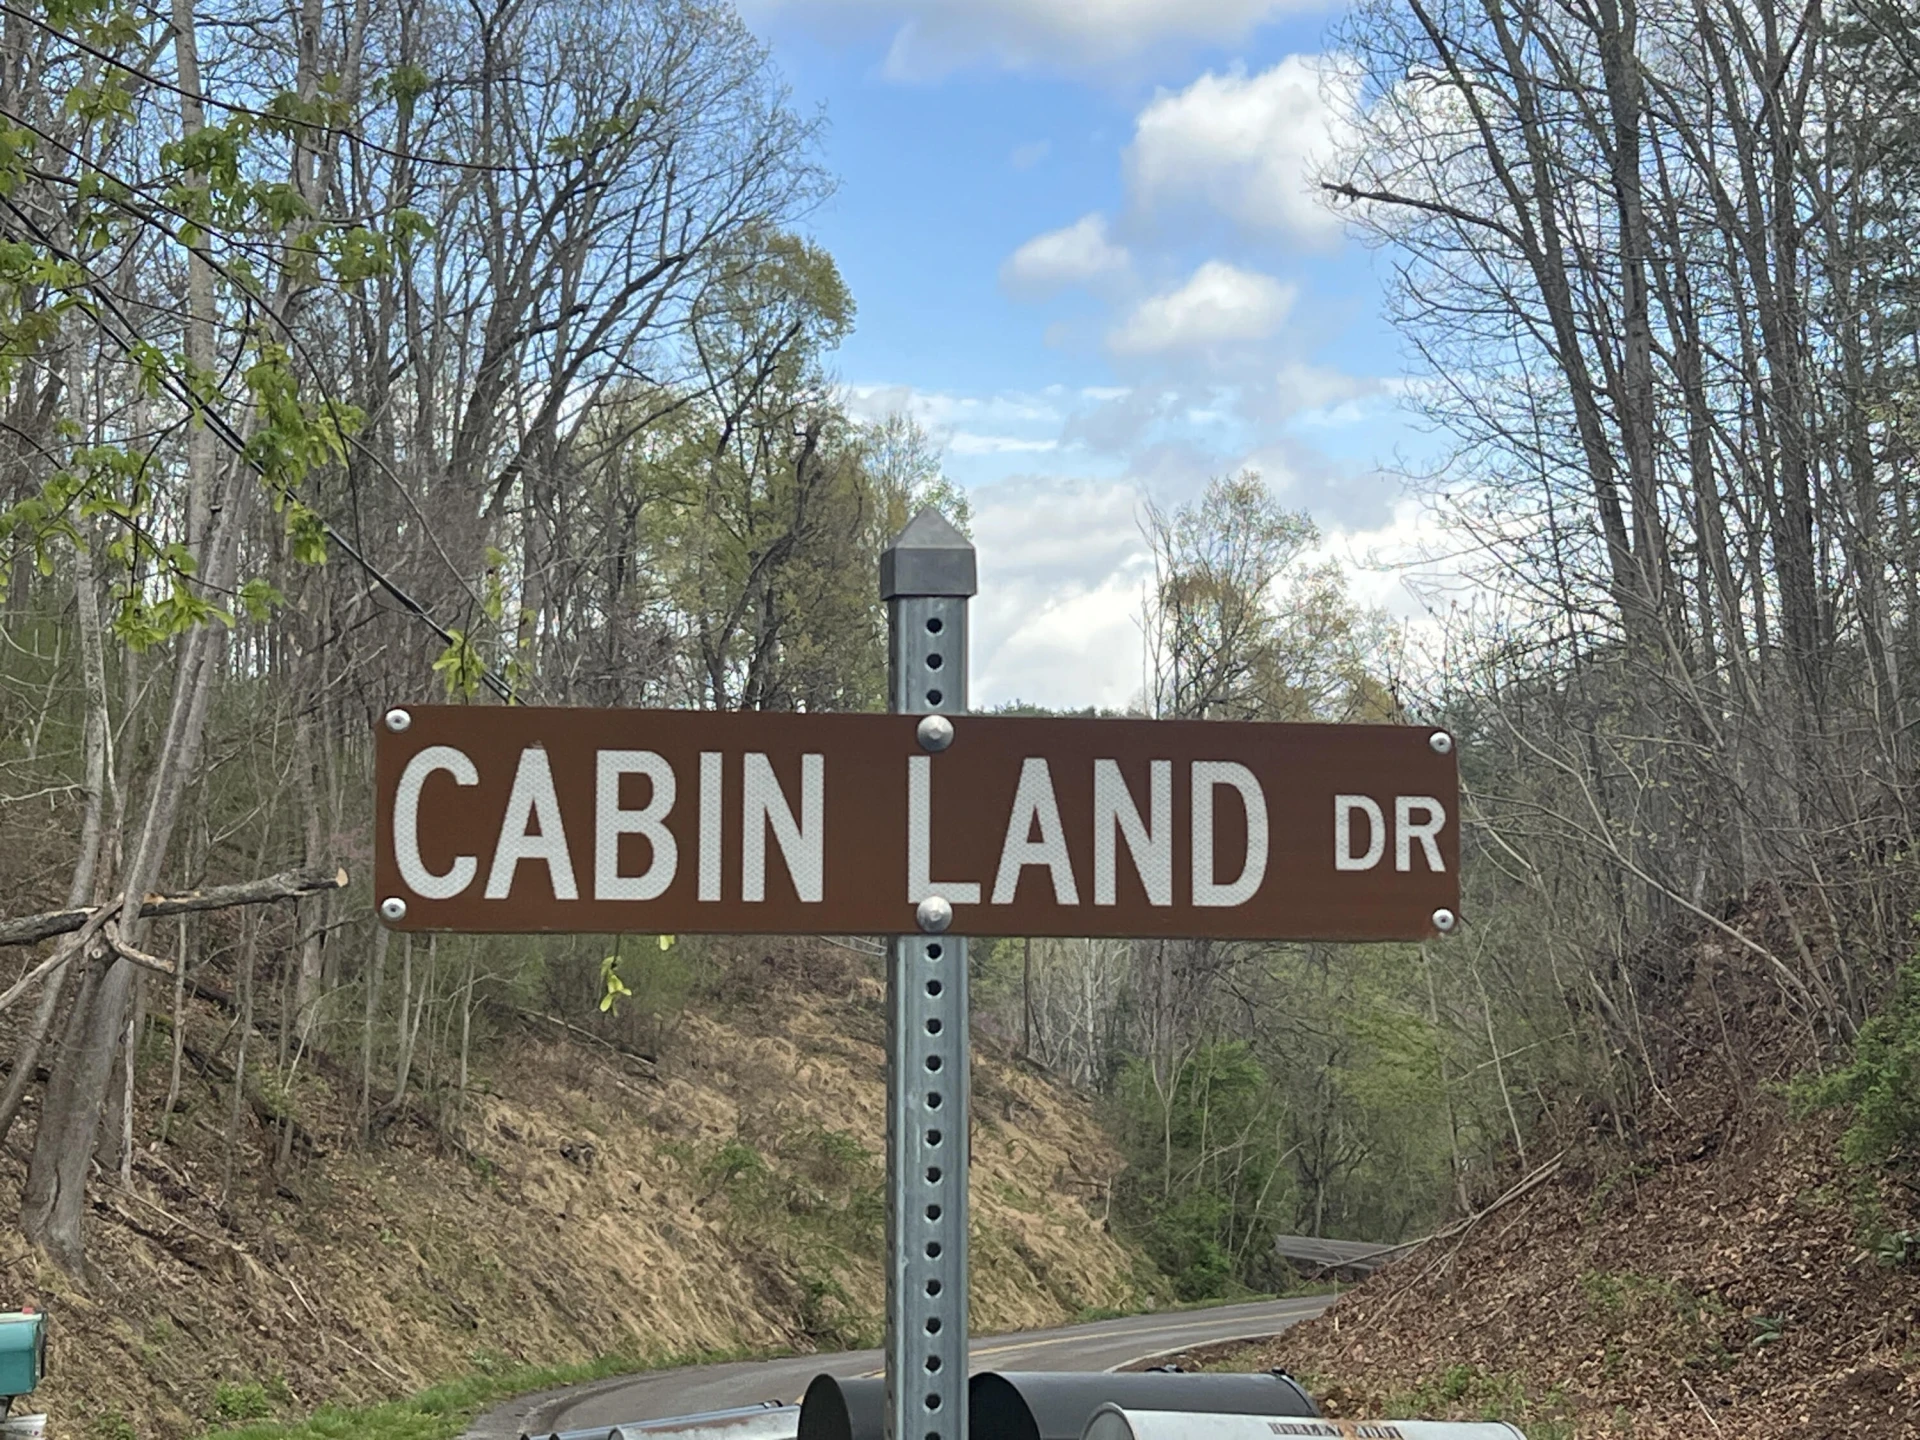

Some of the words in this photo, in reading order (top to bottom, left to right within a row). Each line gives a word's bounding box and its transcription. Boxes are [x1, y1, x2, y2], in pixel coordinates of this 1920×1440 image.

[393, 745, 825, 903] CABIN
[907, 755, 1270, 907] LAND
[1334, 794, 1447, 872] DR
